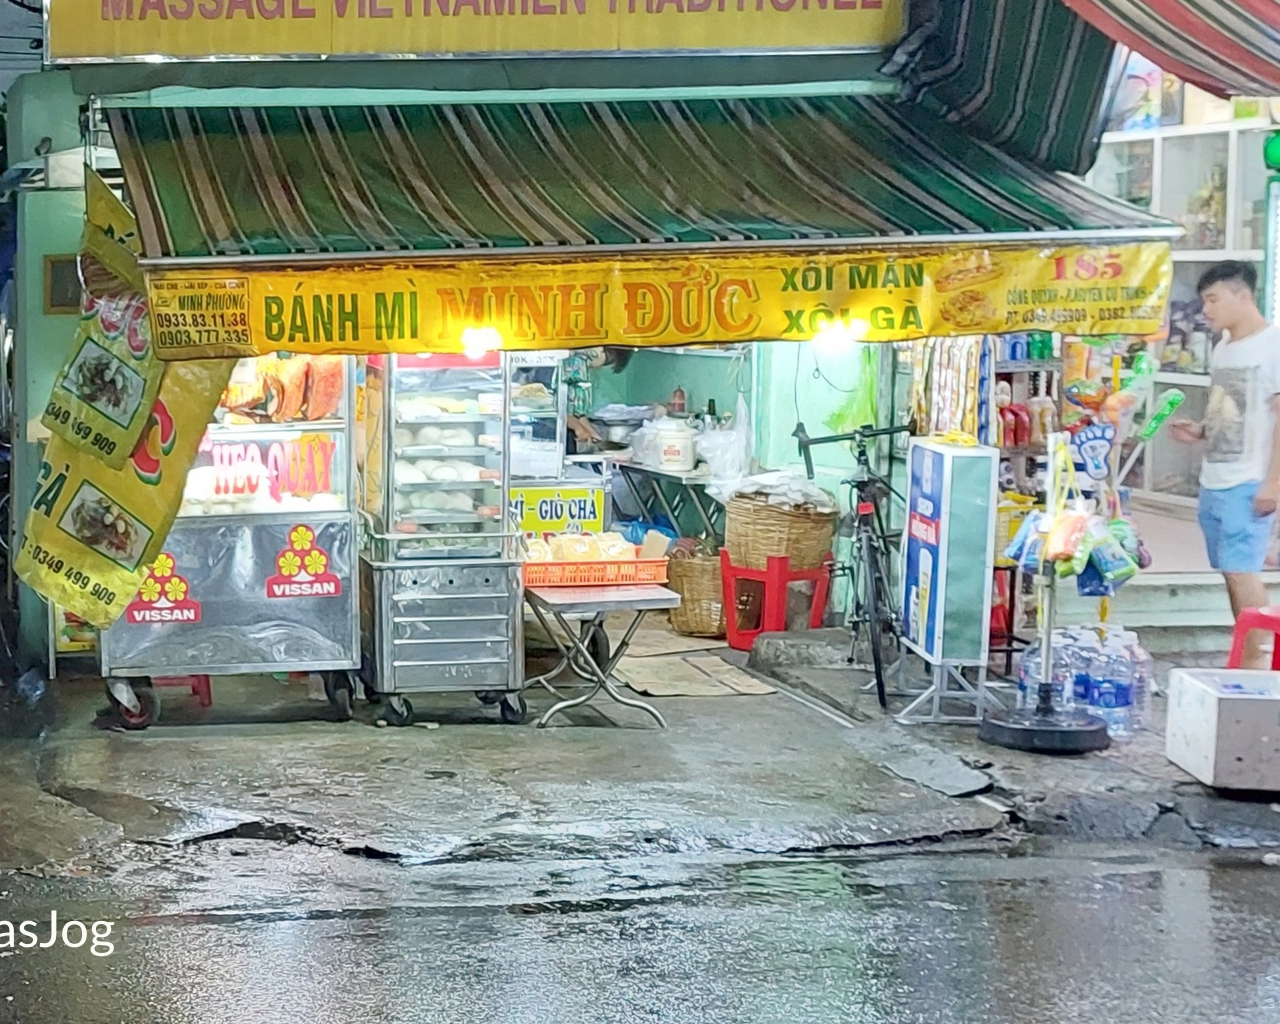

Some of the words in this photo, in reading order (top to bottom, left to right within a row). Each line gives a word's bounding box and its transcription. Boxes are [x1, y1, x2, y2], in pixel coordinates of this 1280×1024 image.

[780, 260, 834, 292] XÔI
[848, 257, 924, 294] MẶN
[1049, 252, 1124, 282] 185
[178, 294, 203, 311] MINH
[264, 281, 360, 343] BÁNH
[376, 277, 419, 341] MÌ
[436, 282, 609, 341] MINH
[621, 263, 762, 339] ĐỨC
[870, 299, 923, 331] GÀ
[157, 312, 247, 328] 0933.83.11.38
[160, 329, 249, 345] 0903.777.335
[46, 402, 70, 425] 349
[91, 432, 117, 455] 909
[267, 441, 336, 503] QUAY
[539, 493, 564, 521] GIÒ
[568, 488, 597, 520] CHẢ
[64, 567, 91, 590] 499
[90, 583, 117, 606] 909
[273, 582, 336, 596] VISSAN
[132, 609, 195, 622] VISSAN
